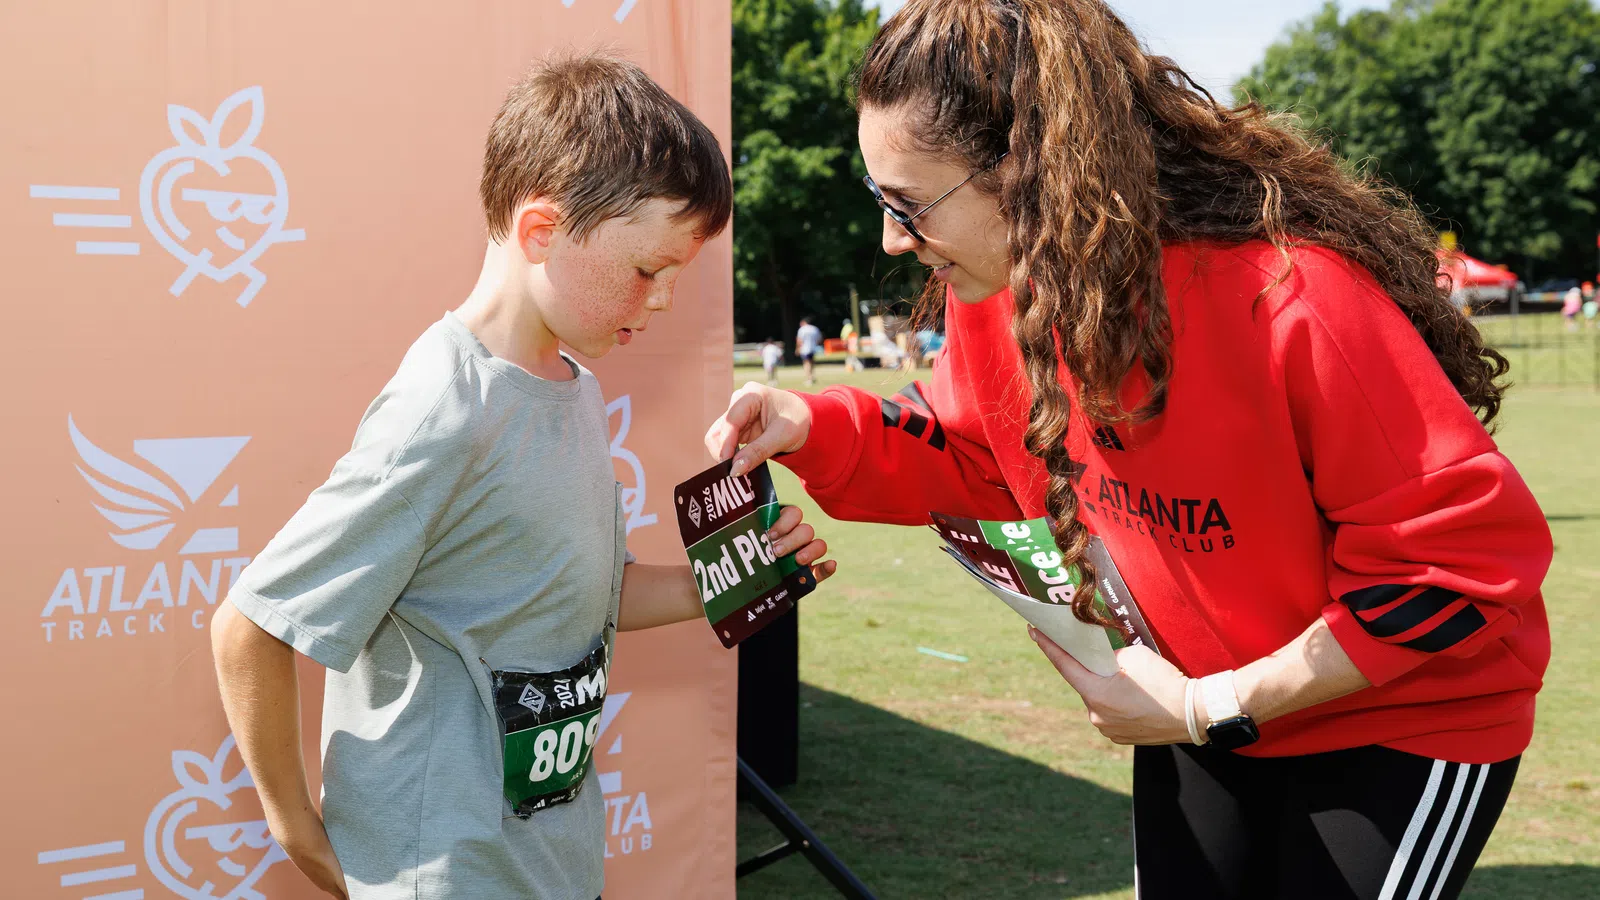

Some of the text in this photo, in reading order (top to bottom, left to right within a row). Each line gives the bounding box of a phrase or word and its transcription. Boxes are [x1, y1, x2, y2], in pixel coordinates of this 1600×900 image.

[702, 486, 717, 522] 2026
[712, 474, 755, 518] MIL
[1098, 474, 1232, 535] ATLANTA
[1101, 506, 1236, 552] TRACK CLUB
[40, 557, 251, 618] ATLANT
[693, 528, 777, 604] 2nd Pla
[1030, 550, 1076, 605] ace
[40, 612, 165, 643] TRACK
[604, 833, 653, 858] LUB
